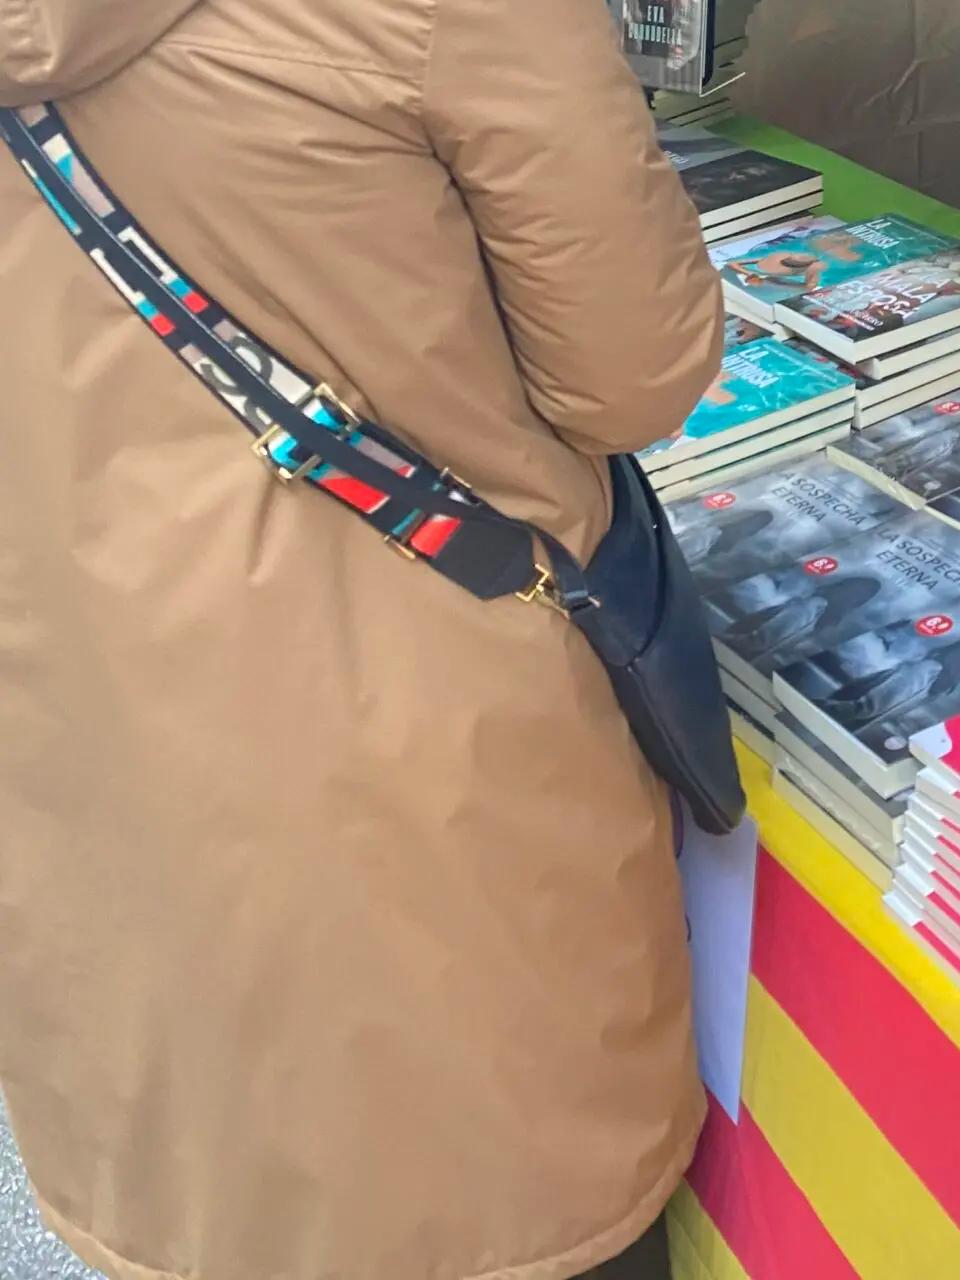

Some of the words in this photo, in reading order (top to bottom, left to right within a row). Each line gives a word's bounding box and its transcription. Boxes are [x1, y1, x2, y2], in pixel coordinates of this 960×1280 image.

[738, 346, 769, 362] LA
[877, 528, 901, 543] LA
[875, 549, 939, 591] ETERNA
